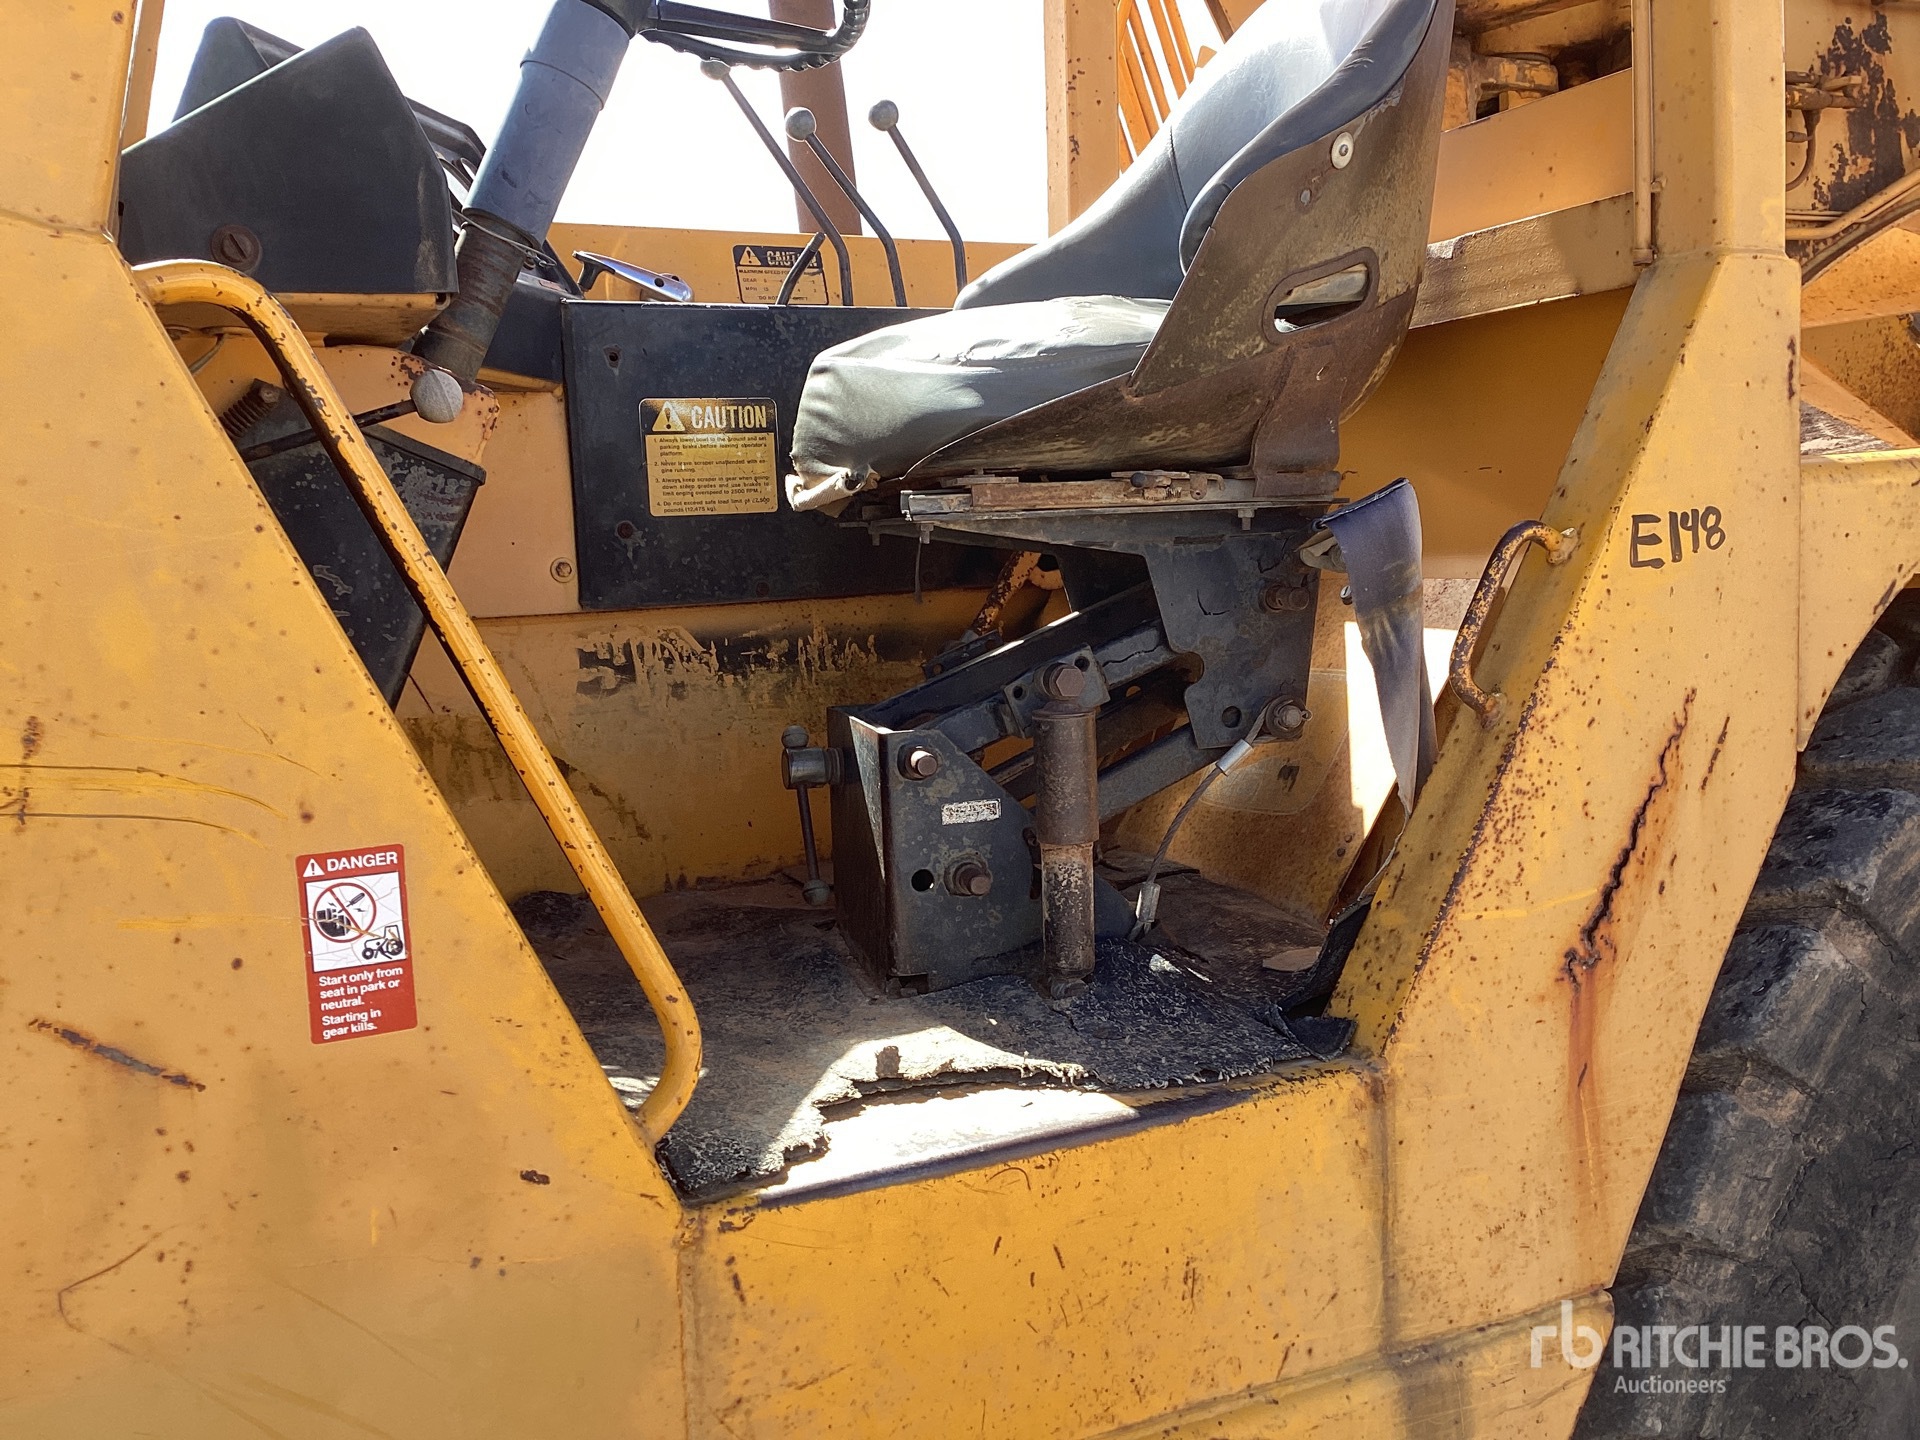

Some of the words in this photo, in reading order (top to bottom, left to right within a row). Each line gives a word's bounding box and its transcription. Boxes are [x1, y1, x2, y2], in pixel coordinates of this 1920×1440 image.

[767, 250, 818, 267] CAUTN
[691, 405, 767, 429] CAUTION
[1630, 505, 1726, 569] E148
[326, 851, 398, 872] DANGER
[319, 974, 347, 987] Start
[349, 970, 374, 982] only
[376, 967, 403, 978] from
[320, 986, 345, 999] seat
[347, 985, 358, 994] in
[360, 980, 386, 995] park
[388, 979, 400, 988] or
[321, 996, 365, 1011] neutral.
[322, 1011, 368, 1026] Starting
[370, 1009, 381, 1018] in
[323, 1026, 349, 1040] gear
[351, 1022, 377, 1033] kills.
